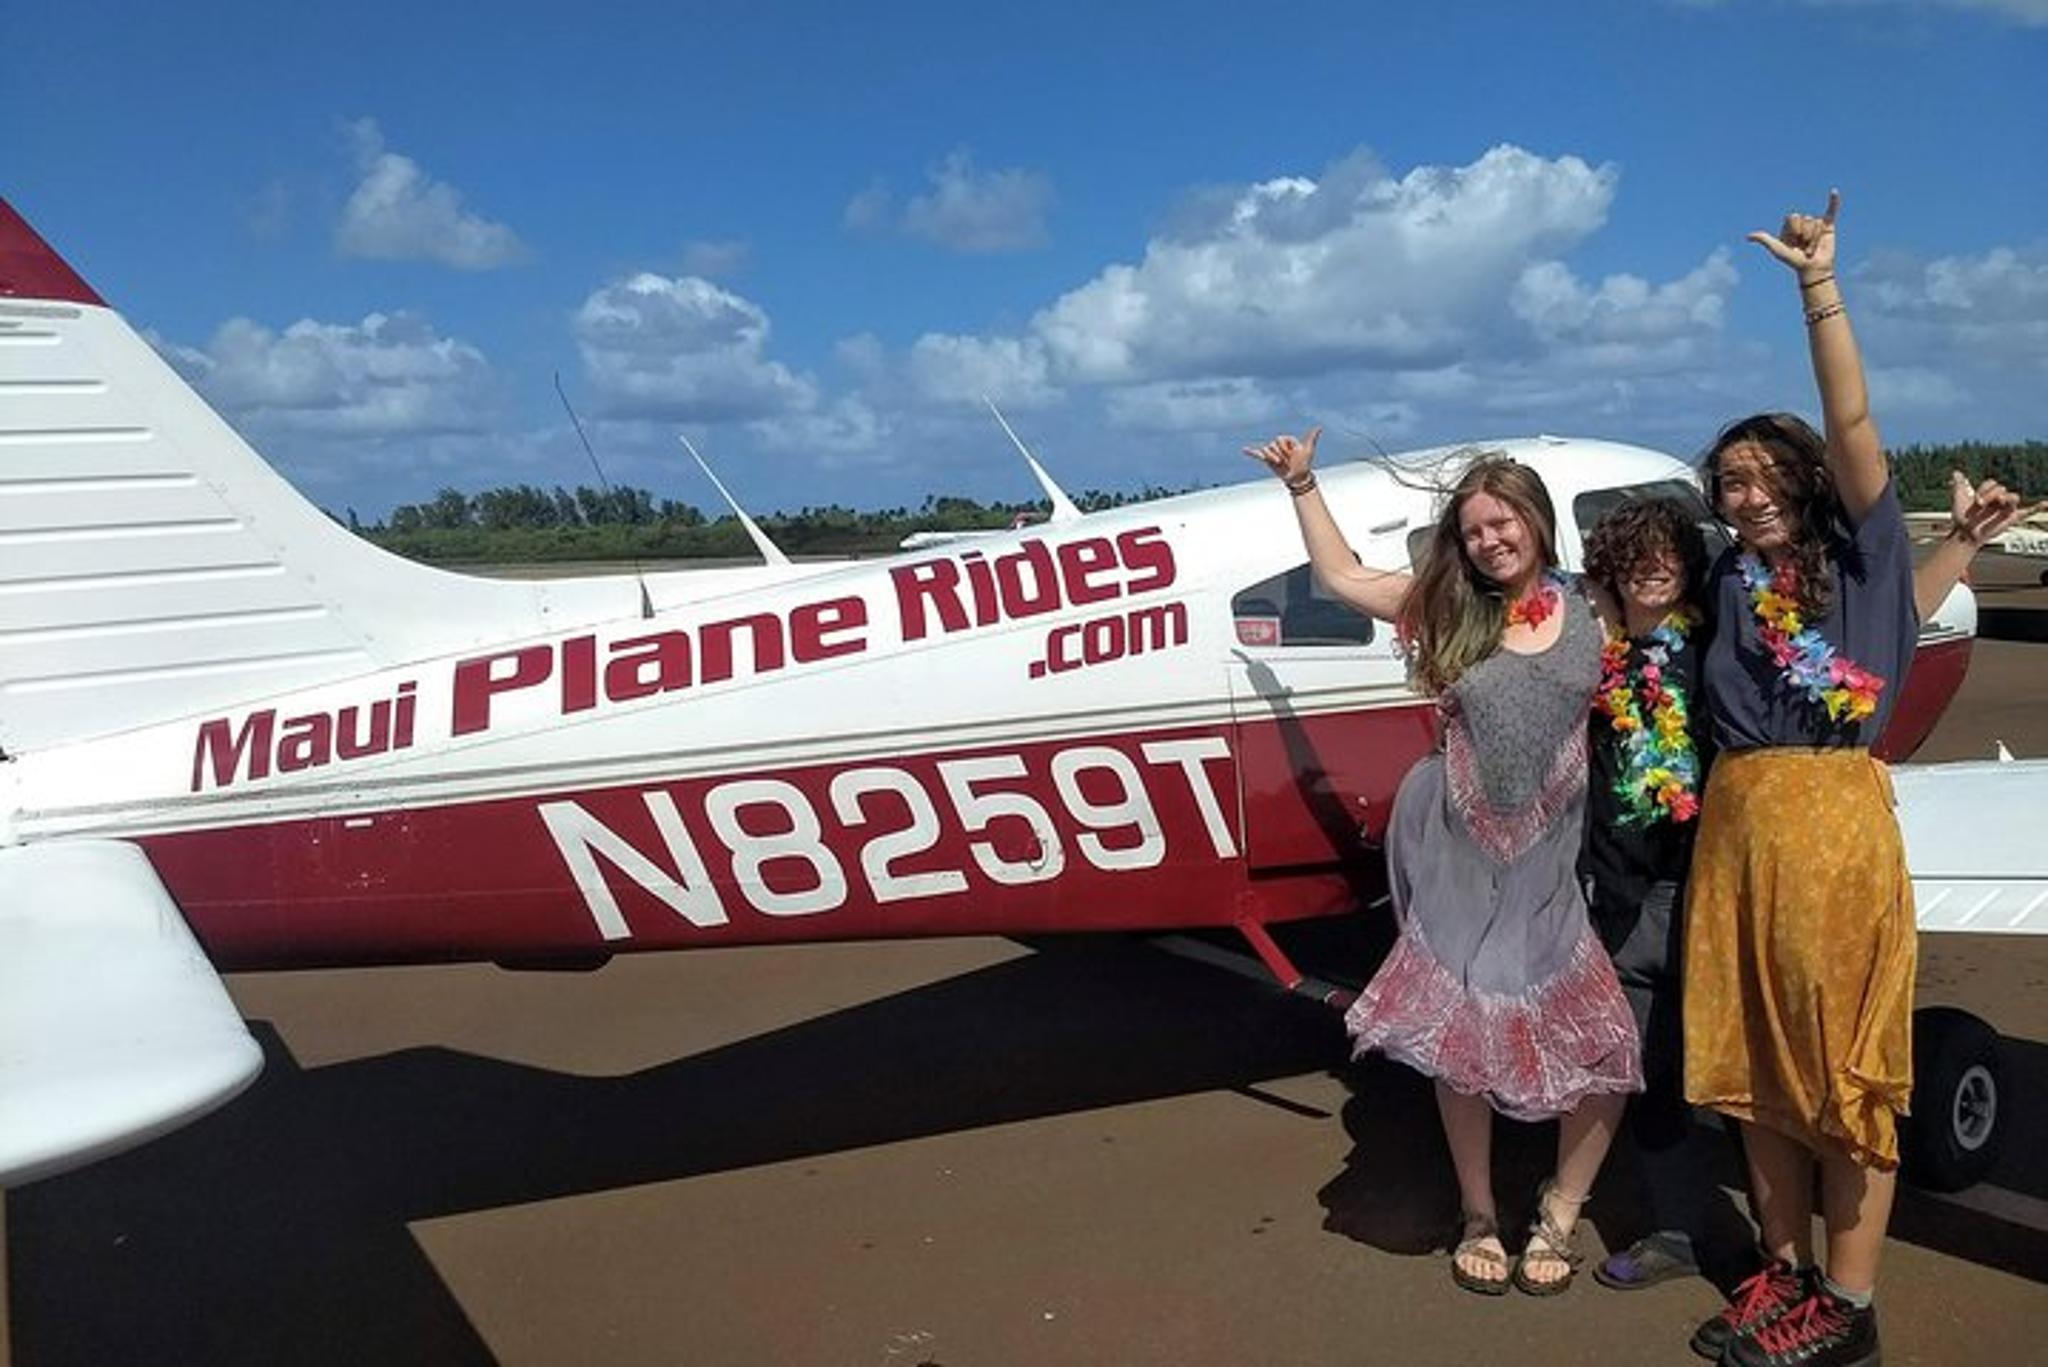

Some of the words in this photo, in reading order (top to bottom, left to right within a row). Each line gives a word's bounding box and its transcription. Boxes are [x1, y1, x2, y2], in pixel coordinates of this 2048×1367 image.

[191, 680, 417, 791] Maui
[451, 595, 867, 737] Plane
[889, 526, 1178, 641] Rides
[1028, 601, 1188, 679] .com
[538, 737, 1238, 941] N8259T
